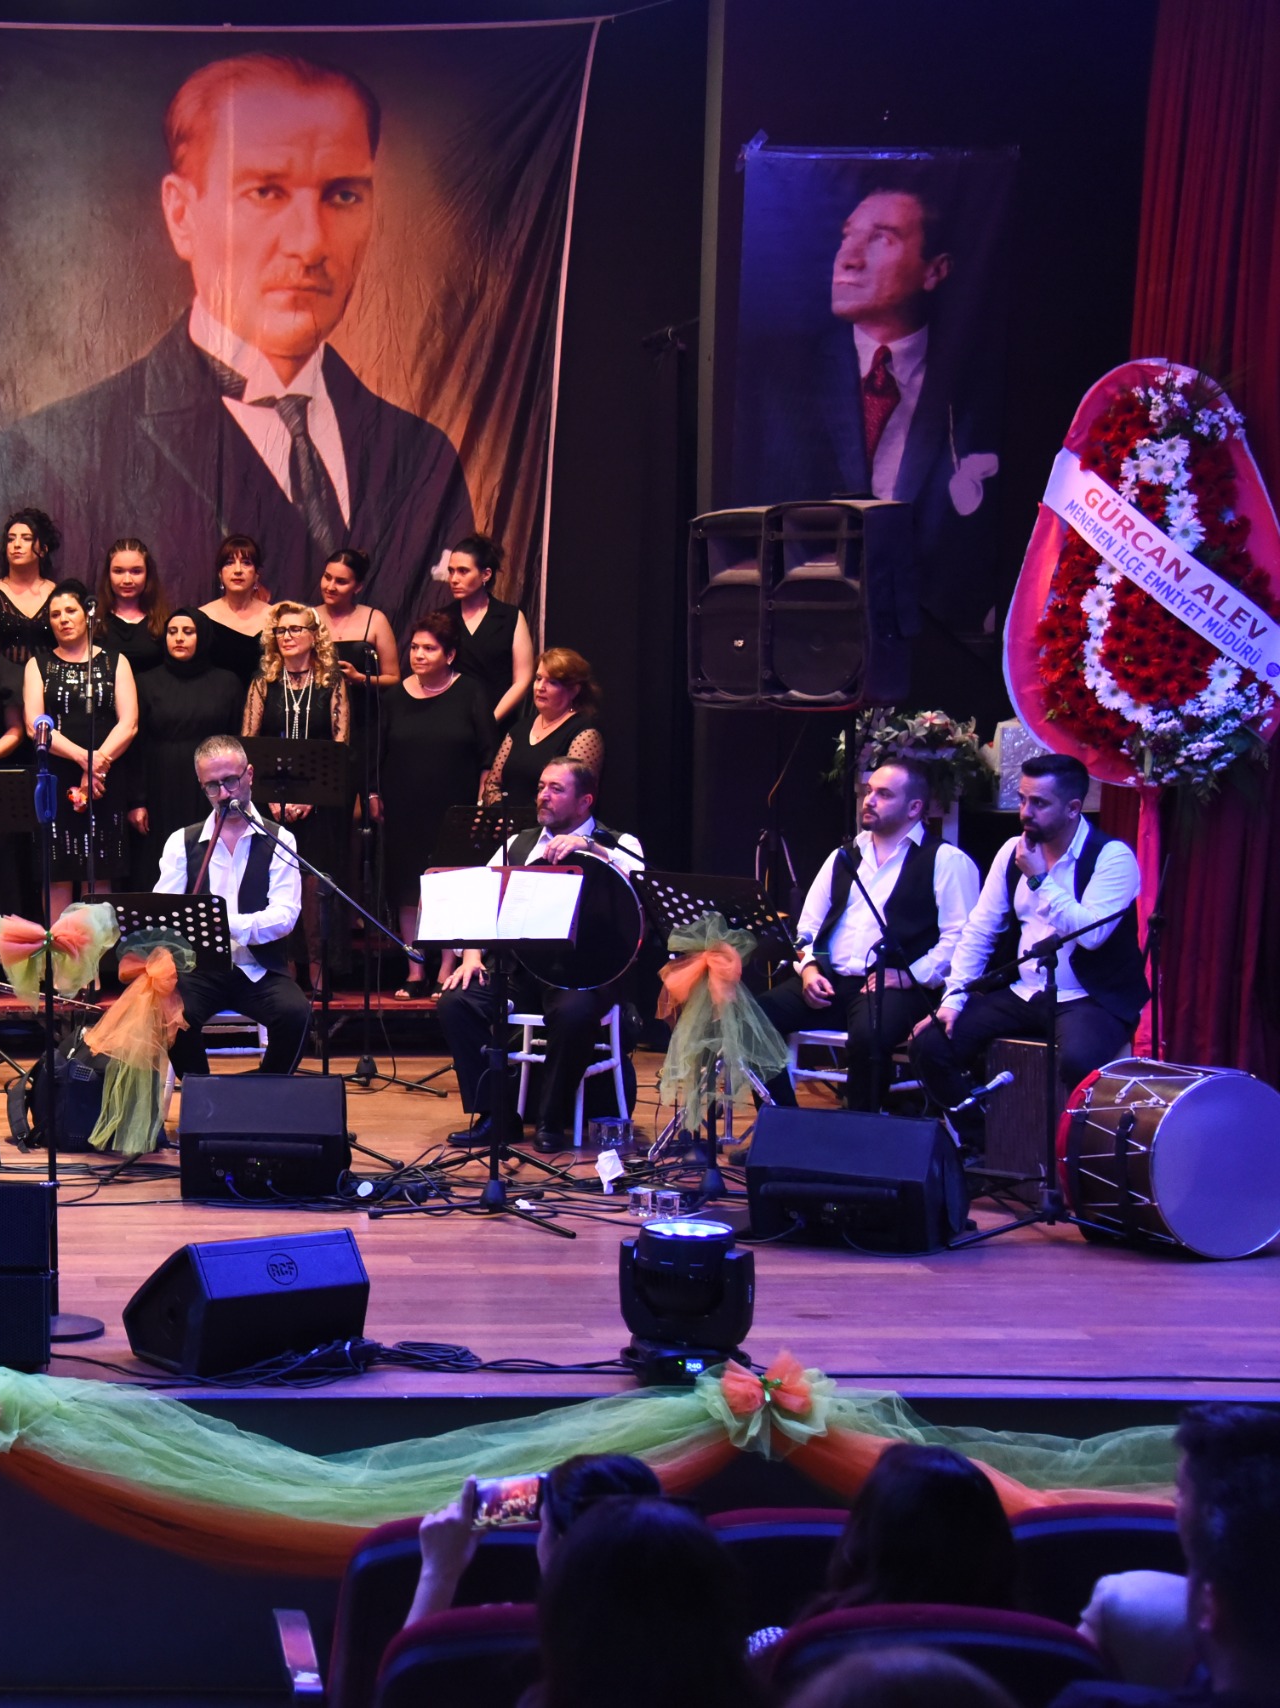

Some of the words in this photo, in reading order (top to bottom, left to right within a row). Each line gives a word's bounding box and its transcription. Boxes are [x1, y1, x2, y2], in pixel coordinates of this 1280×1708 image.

[1064, 498, 1118, 552] MENEMEN
[1112, 542, 1147, 577] İLÇE
[1142, 571, 1207, 622] EMNİYET
[1201, 616, 1264, 667] MÜDÜRÜ
[1084, 487, 1192, 584] GÜRCAN
[1190, 583, 1268, 641] ALEV
[686, 1362, 703, 1370] 240
